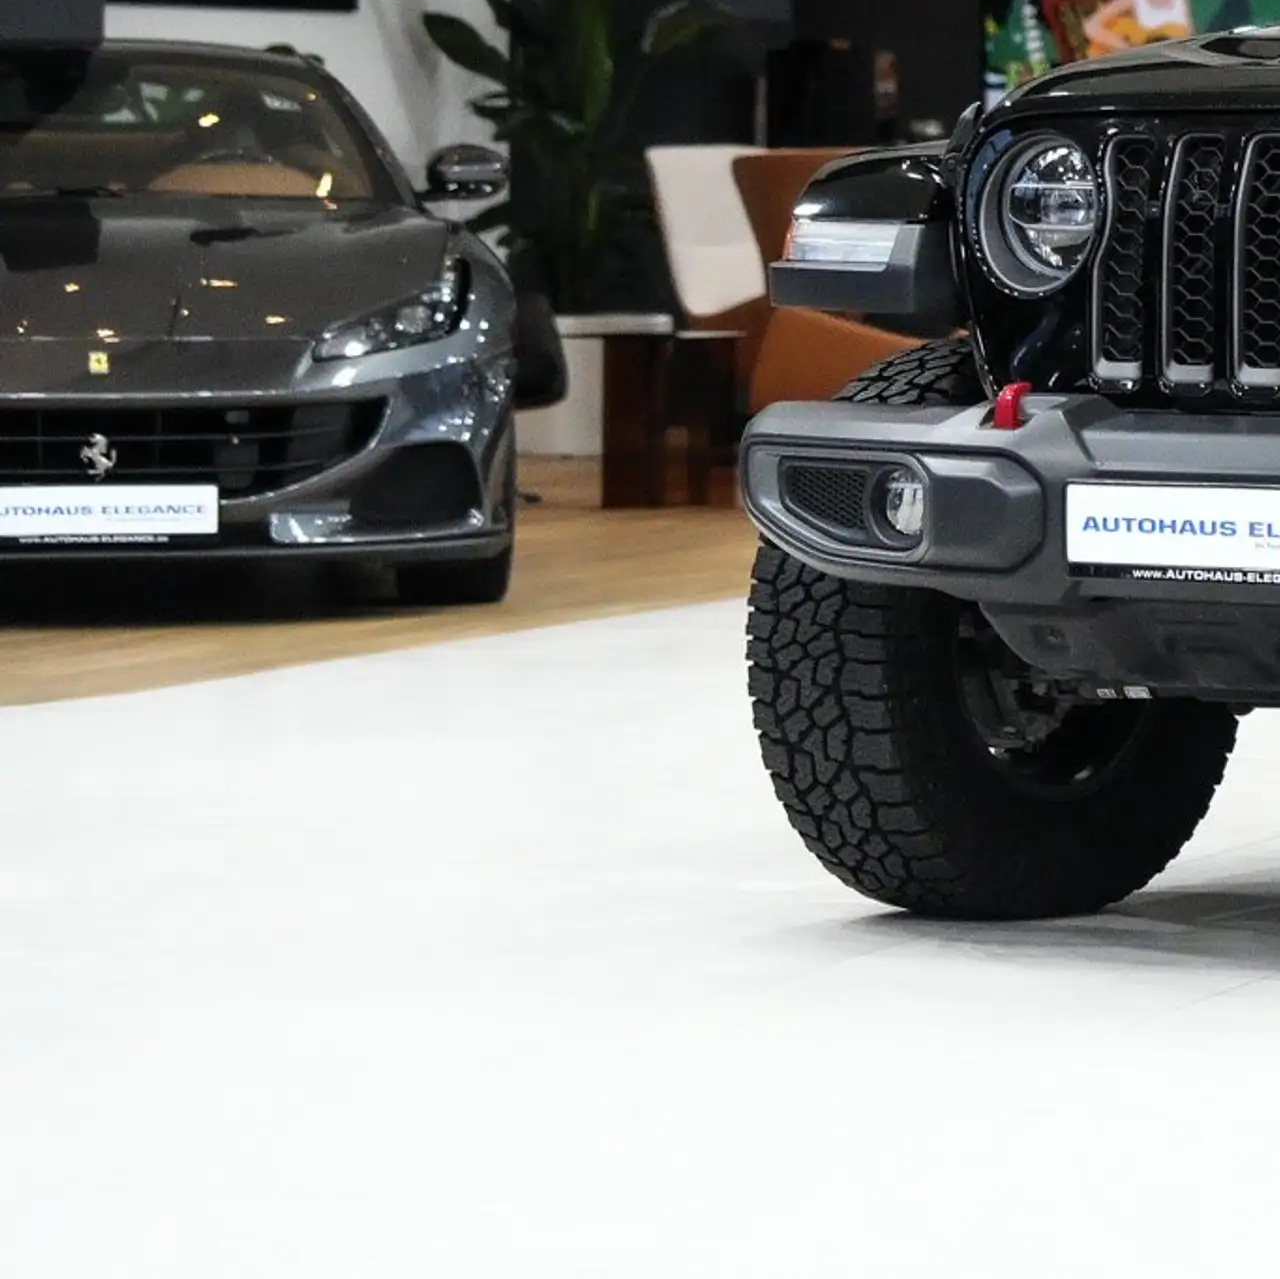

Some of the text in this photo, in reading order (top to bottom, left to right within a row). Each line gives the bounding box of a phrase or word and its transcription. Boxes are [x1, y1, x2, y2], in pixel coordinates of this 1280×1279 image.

[0, 505, 208, 517] UTOHAUS ELEGANCE
[1082, 516, 1238, 537] AUTOHAUS
